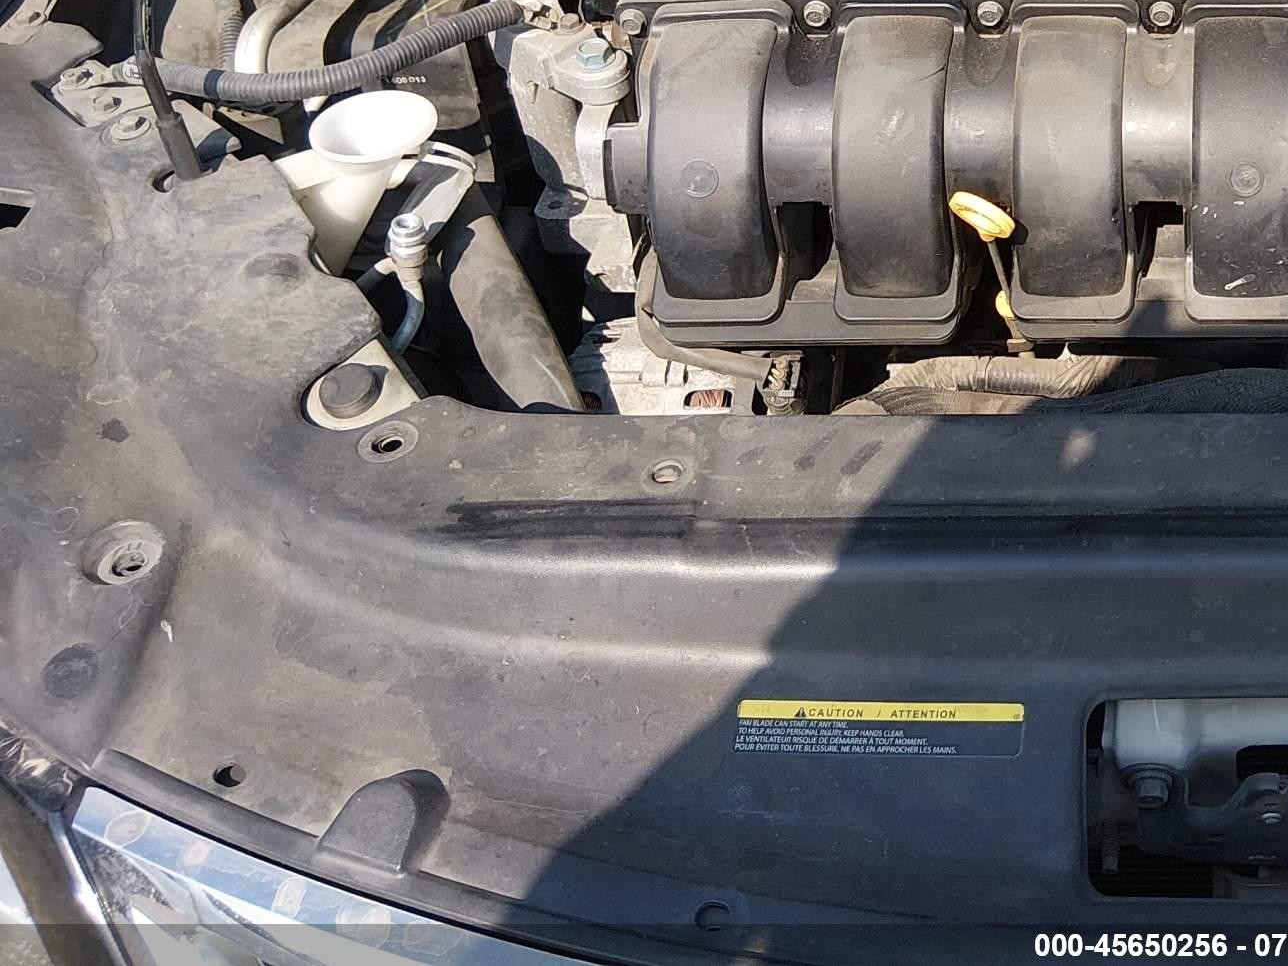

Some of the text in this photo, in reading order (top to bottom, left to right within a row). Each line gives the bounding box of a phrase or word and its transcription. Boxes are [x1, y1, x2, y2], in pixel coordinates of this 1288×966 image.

[809, 708, 863, 718] CAUTION
[890, 709, 957, 719] ATTENTION
[745, 735, 791, 743] VENTILATEUR
[792, 736, 817, 744] RISQUE
[734, 743, 754, 751] POUR
[780, 744, 803, 752] TOUTE
[840, 745, 852, 753] NE
[851, 745, 864, 753] PAS
[876, 746, 918, 754] APPROCHER
